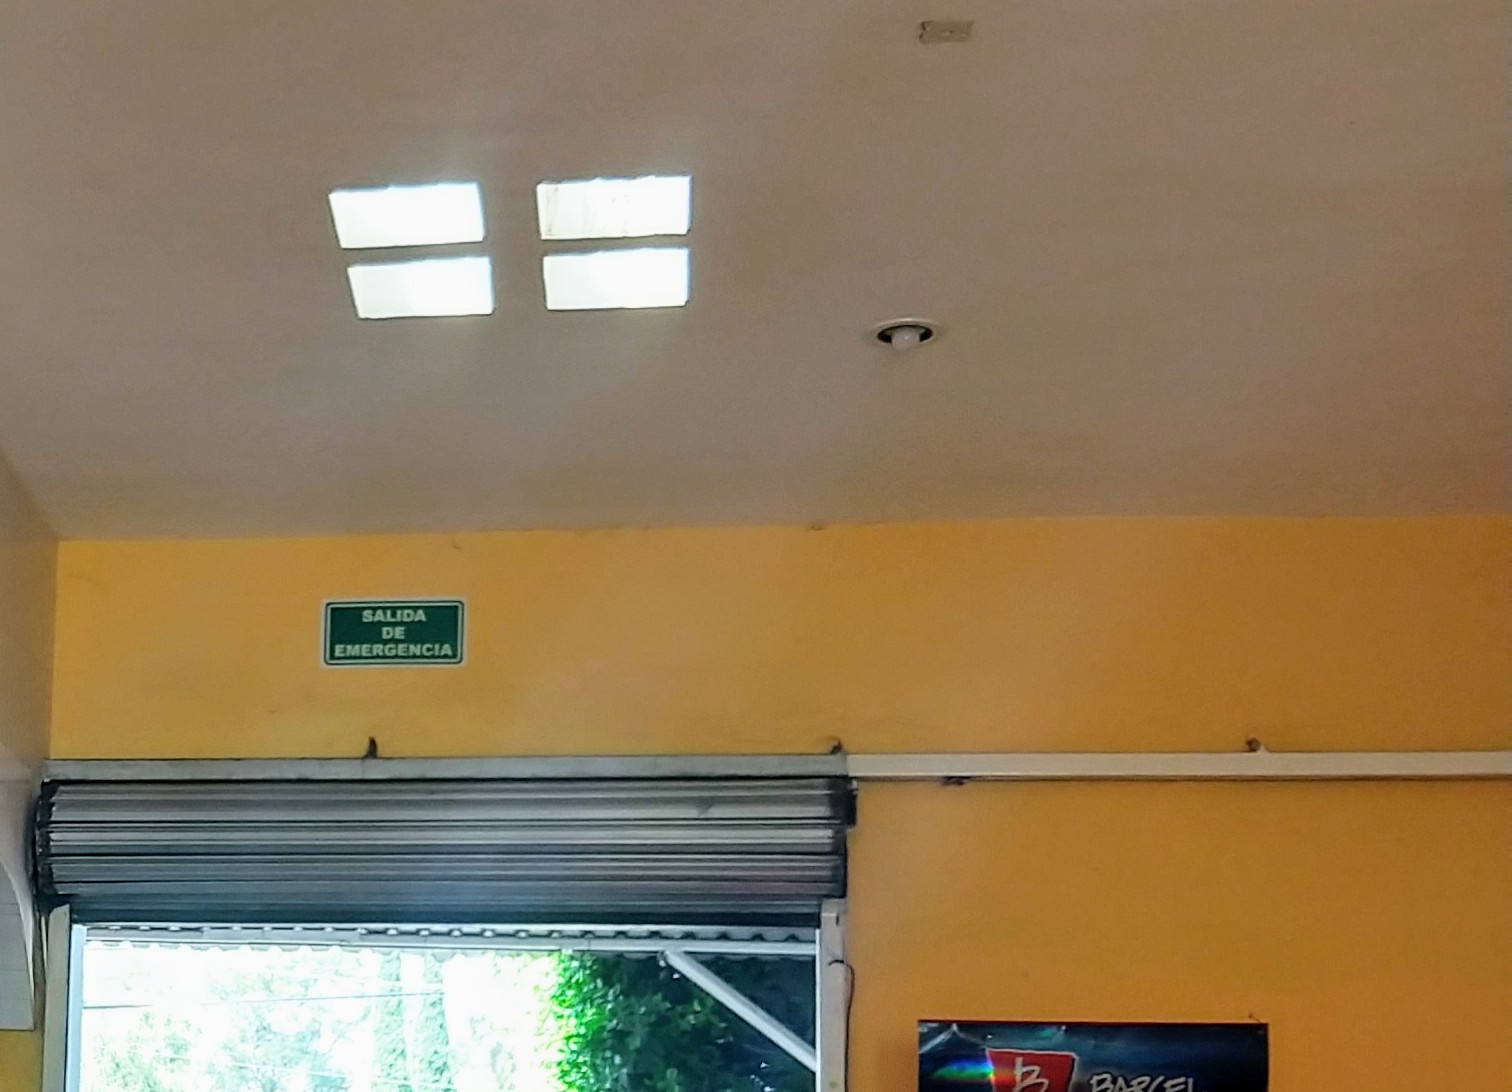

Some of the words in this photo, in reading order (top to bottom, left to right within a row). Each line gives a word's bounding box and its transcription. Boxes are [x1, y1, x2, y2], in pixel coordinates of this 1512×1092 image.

[362, 609, 426, 622] SALIDA
[382, 626, 406, 639] DE
[334, 643, 453, 657] EMERGENCIA
